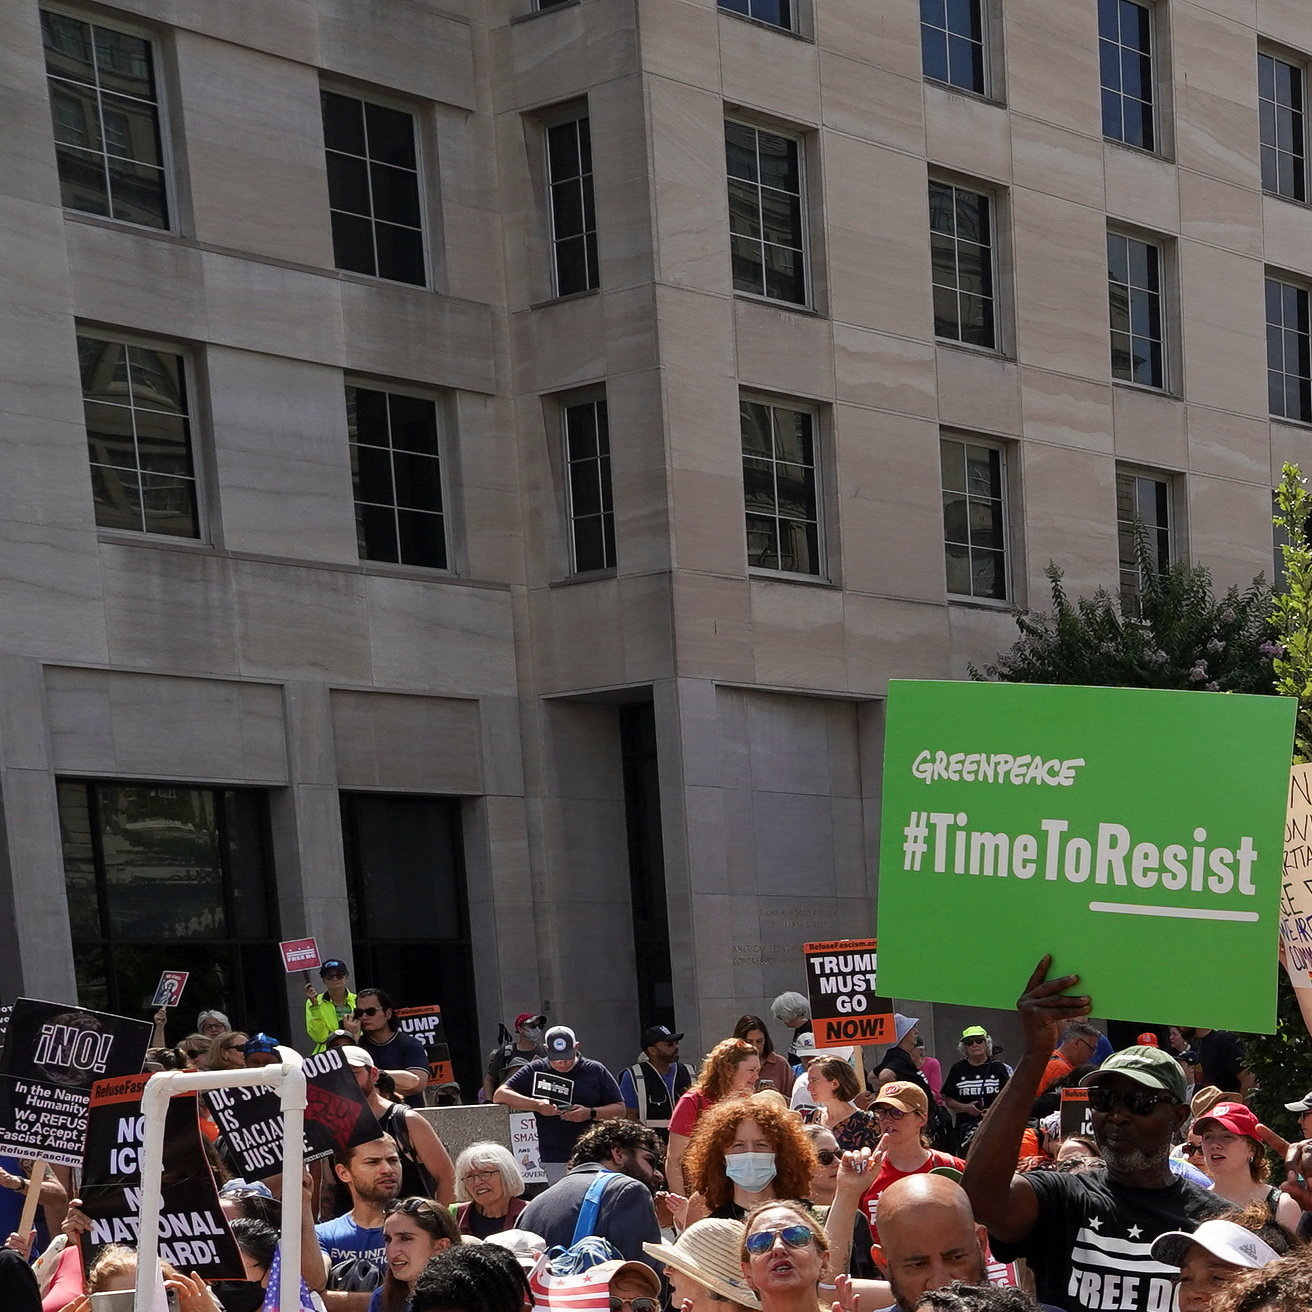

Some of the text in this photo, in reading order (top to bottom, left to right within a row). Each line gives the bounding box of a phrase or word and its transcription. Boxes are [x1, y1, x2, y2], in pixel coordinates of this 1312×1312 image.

[912, 750, 1085, 787] GREENPEACE
[903, 811, 1258, 896] #TimeToResist
[836, 994, 868, 1014] GO
[401, 1015, 440, 1034] UMP
[826, 1017, 885, 1041] NOW!
[34, 1023, 115, 1074] ¡NO!
[15, 1081, 91, 1105] In the Name
[207, 1086, 236, 1112] DC
[26, 1095, 90, 1117] Humanity,
[14, 1107, 88, 1130] We REFUS
[15, 1120, 29, 1132] to
[31, 1122, 79, 1141] Accept
[216, 1107, 240, 1133] IS
[44, 1134, 85, 1152] Ameri
[228, 1116, 285, 1153] RACIA
[0, 1145, 83, 1166] RefuseFascism.
[90, 1210, 225, 1245] NATONAL
[158, 1240, 221, 1266] ARD!
[330, 1247, 387, 1260] EWS UNIT
[1067, 1266, 1140, 1311] FREE
